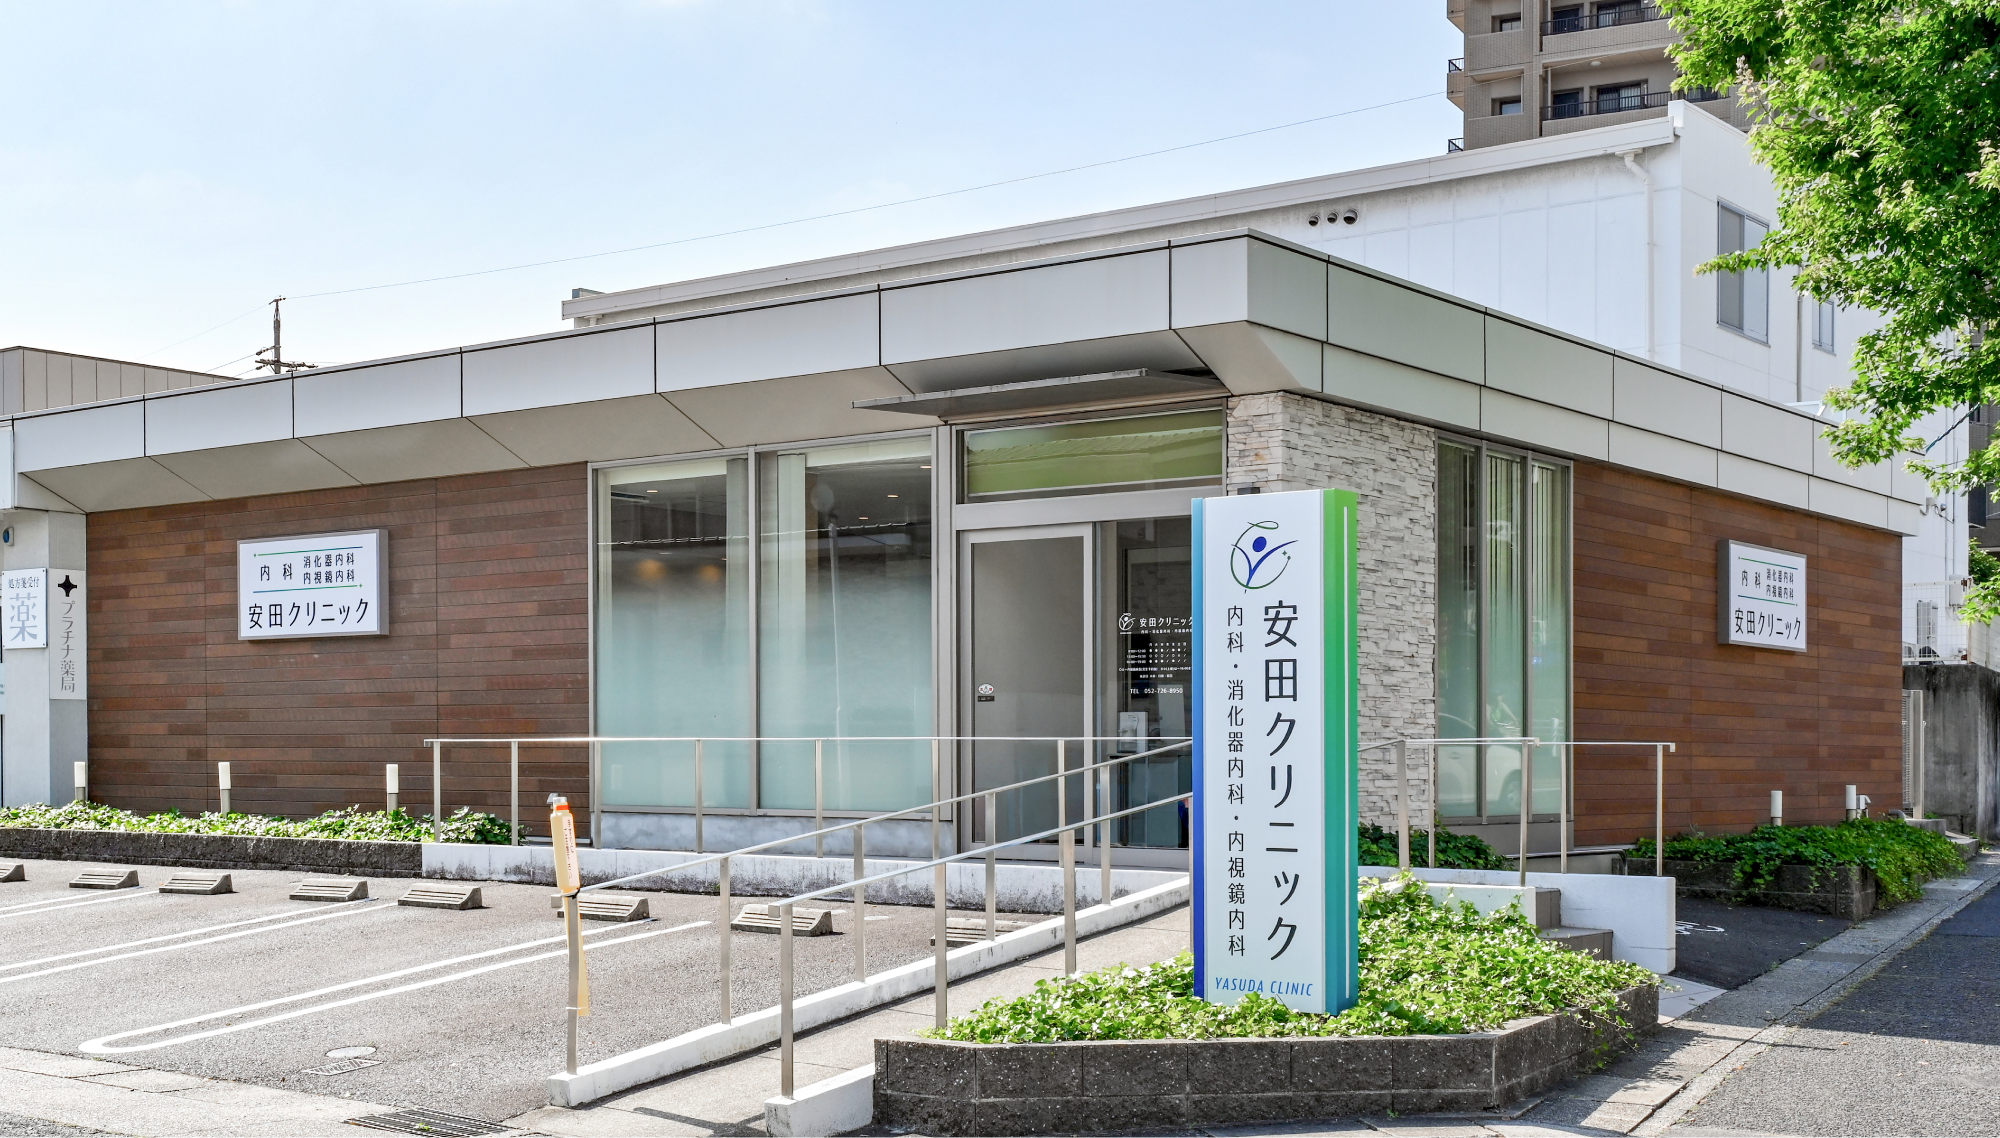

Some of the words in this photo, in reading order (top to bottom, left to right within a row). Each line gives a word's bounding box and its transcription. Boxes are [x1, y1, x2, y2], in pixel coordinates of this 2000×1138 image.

[260, 563, 293, 582] 内科
[303, 552, 355, 569] 消化器内科
[303, 569, 355, 585] 内視鏡内科
[1741, 569, 1761, 589] 内科
[9, 592, 38, 642] 薬
[249, 598, 368, 629] 安田クリニック
[1735, 608, 1801, 640] 安田クリニック
[60, 600, 76, 693] プラチナ薬局
[1264, 600, 1300, 961] 安田クリニック
[1215, 976, 1264, 993] YASUDA
[1270, 980, 1313, 996] CLINIC
